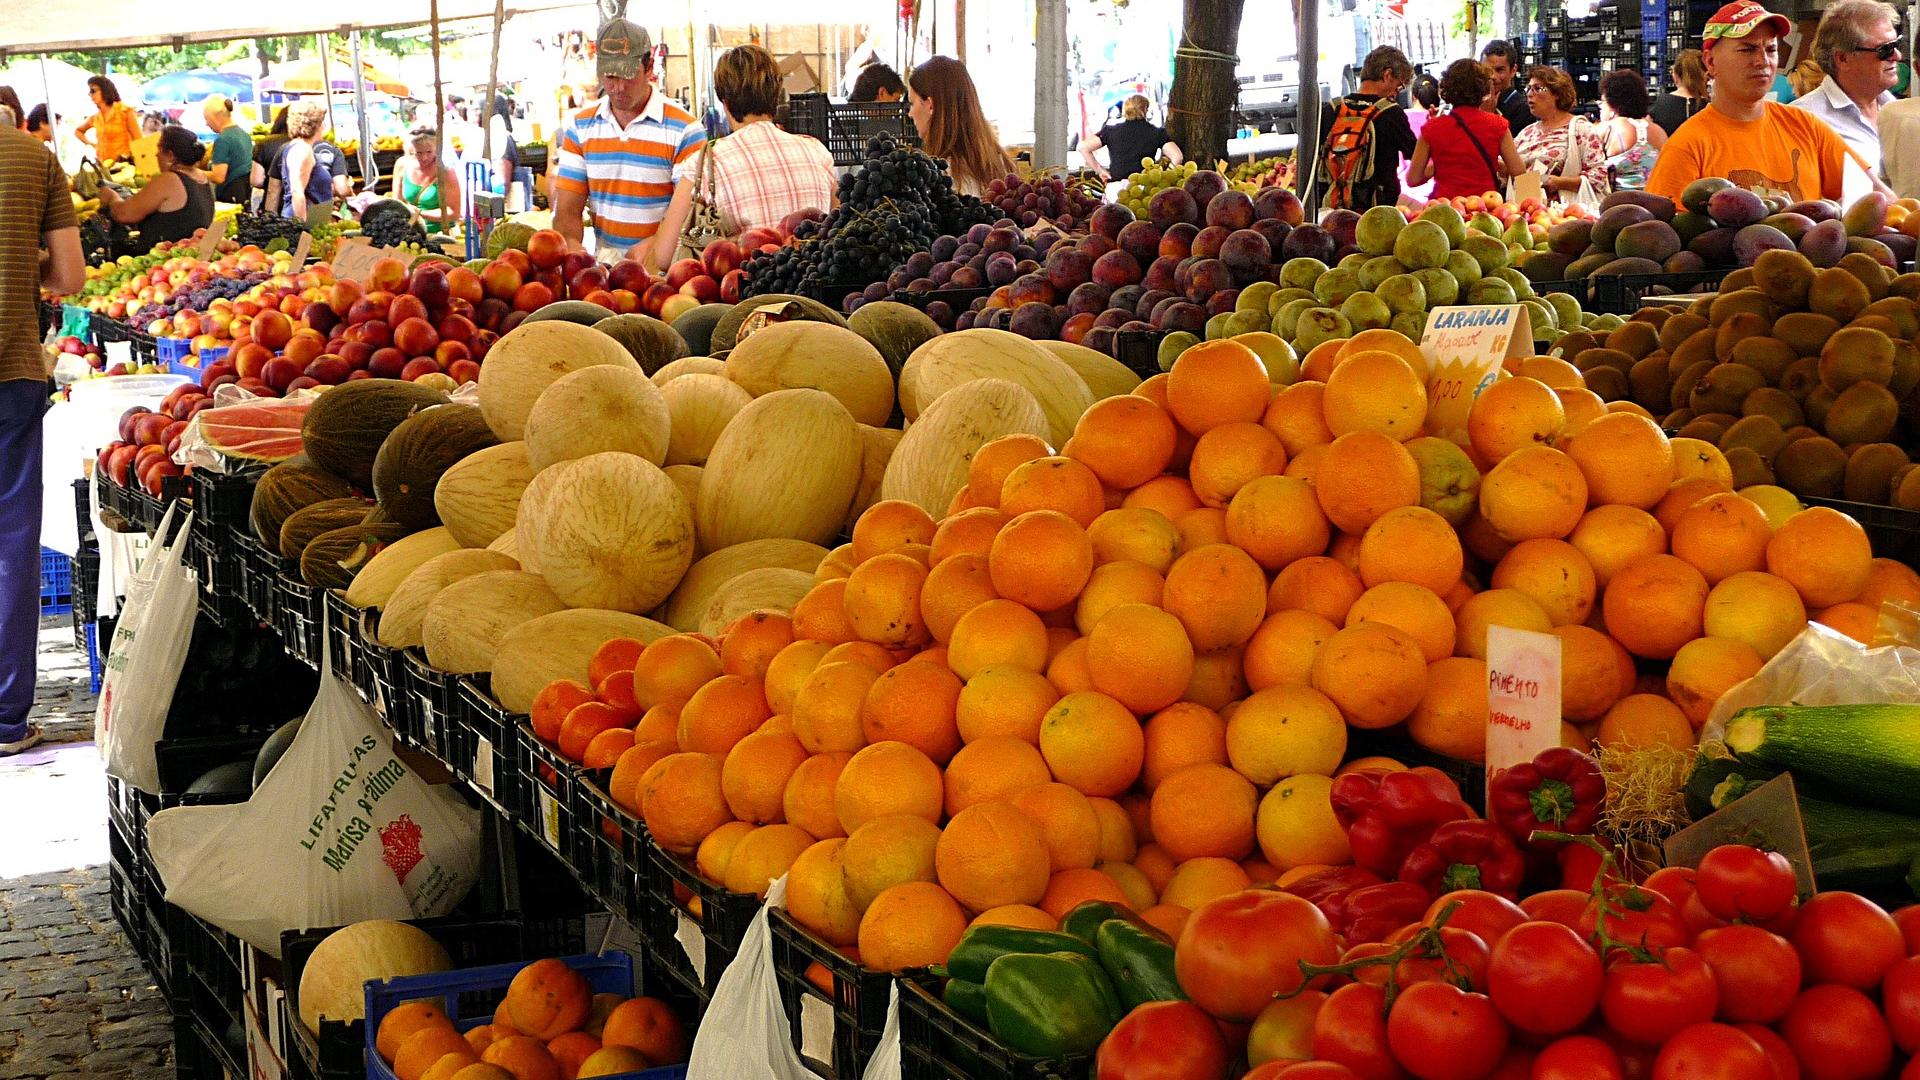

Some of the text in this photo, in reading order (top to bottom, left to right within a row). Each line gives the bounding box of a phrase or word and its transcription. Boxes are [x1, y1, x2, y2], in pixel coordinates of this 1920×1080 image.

[1433, 308, 1511, 329] LARANJA
[1489, 334, 1508, 354] KG
[1489, 710, 1532, 731] VERMELHO
[322, 815, 371, 873] Marisa
[362, 757, 406, 803] átima
